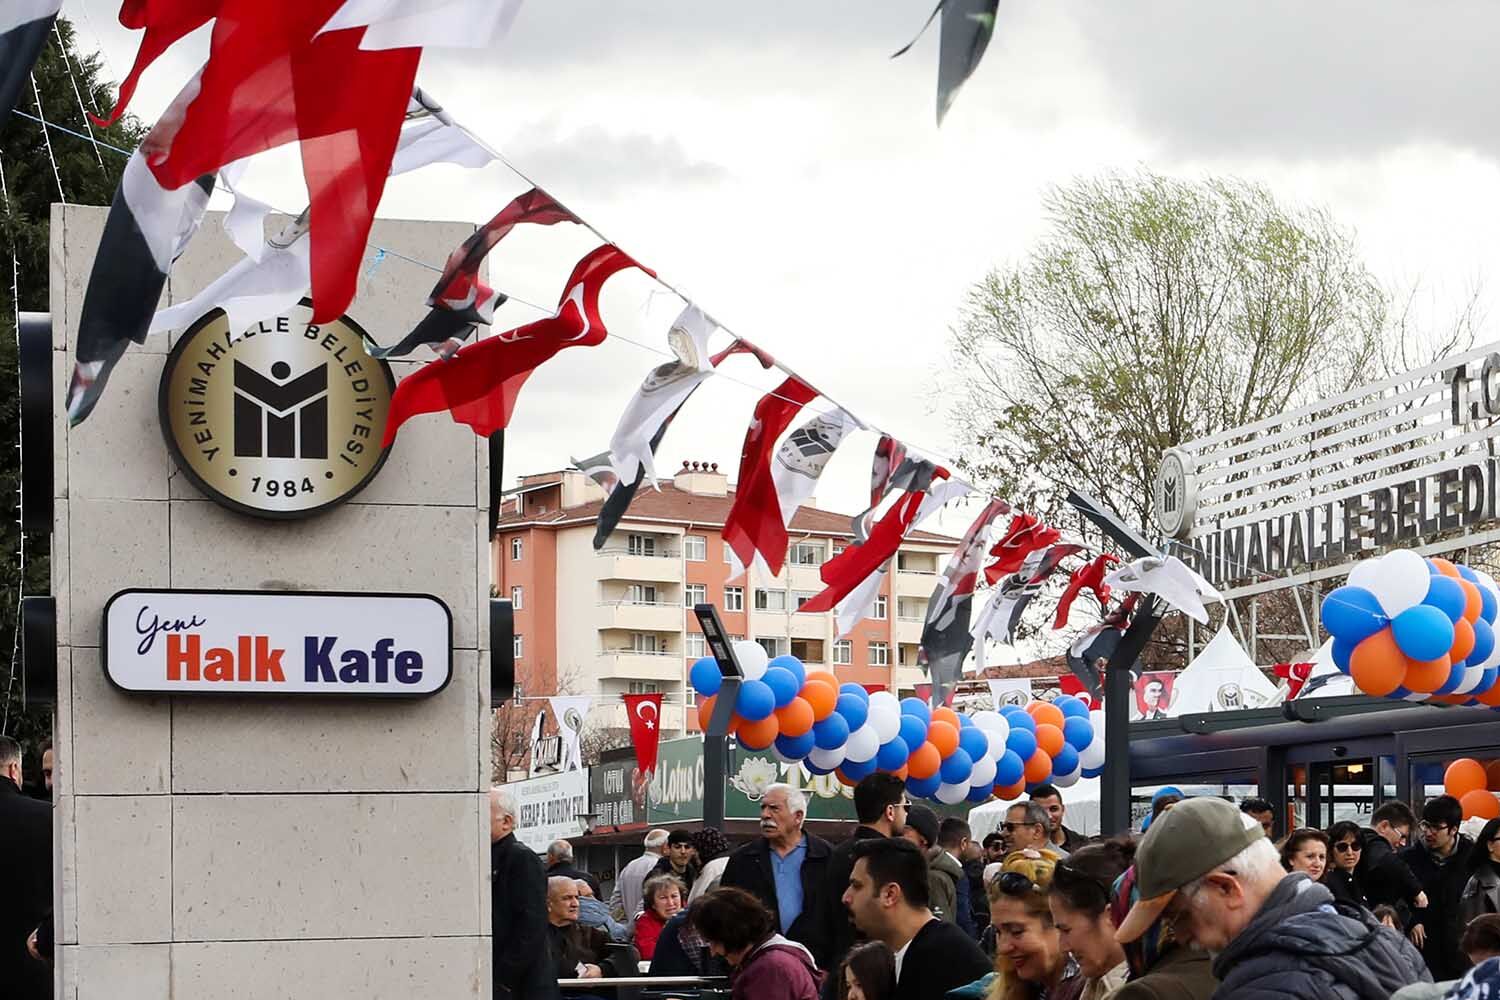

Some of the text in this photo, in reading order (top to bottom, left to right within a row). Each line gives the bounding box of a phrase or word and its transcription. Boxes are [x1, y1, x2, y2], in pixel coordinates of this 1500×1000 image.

[304, 324, 377, 468] BELEDİYESİ
[251, 476, 315, 498] 1984
[136, 605, 206, 655] Yeni
[166, 634, 424, 684] Halk Kafe
[604, 768, 624, 795] LOTUS
[662, 759, 694, 808] Lotus
